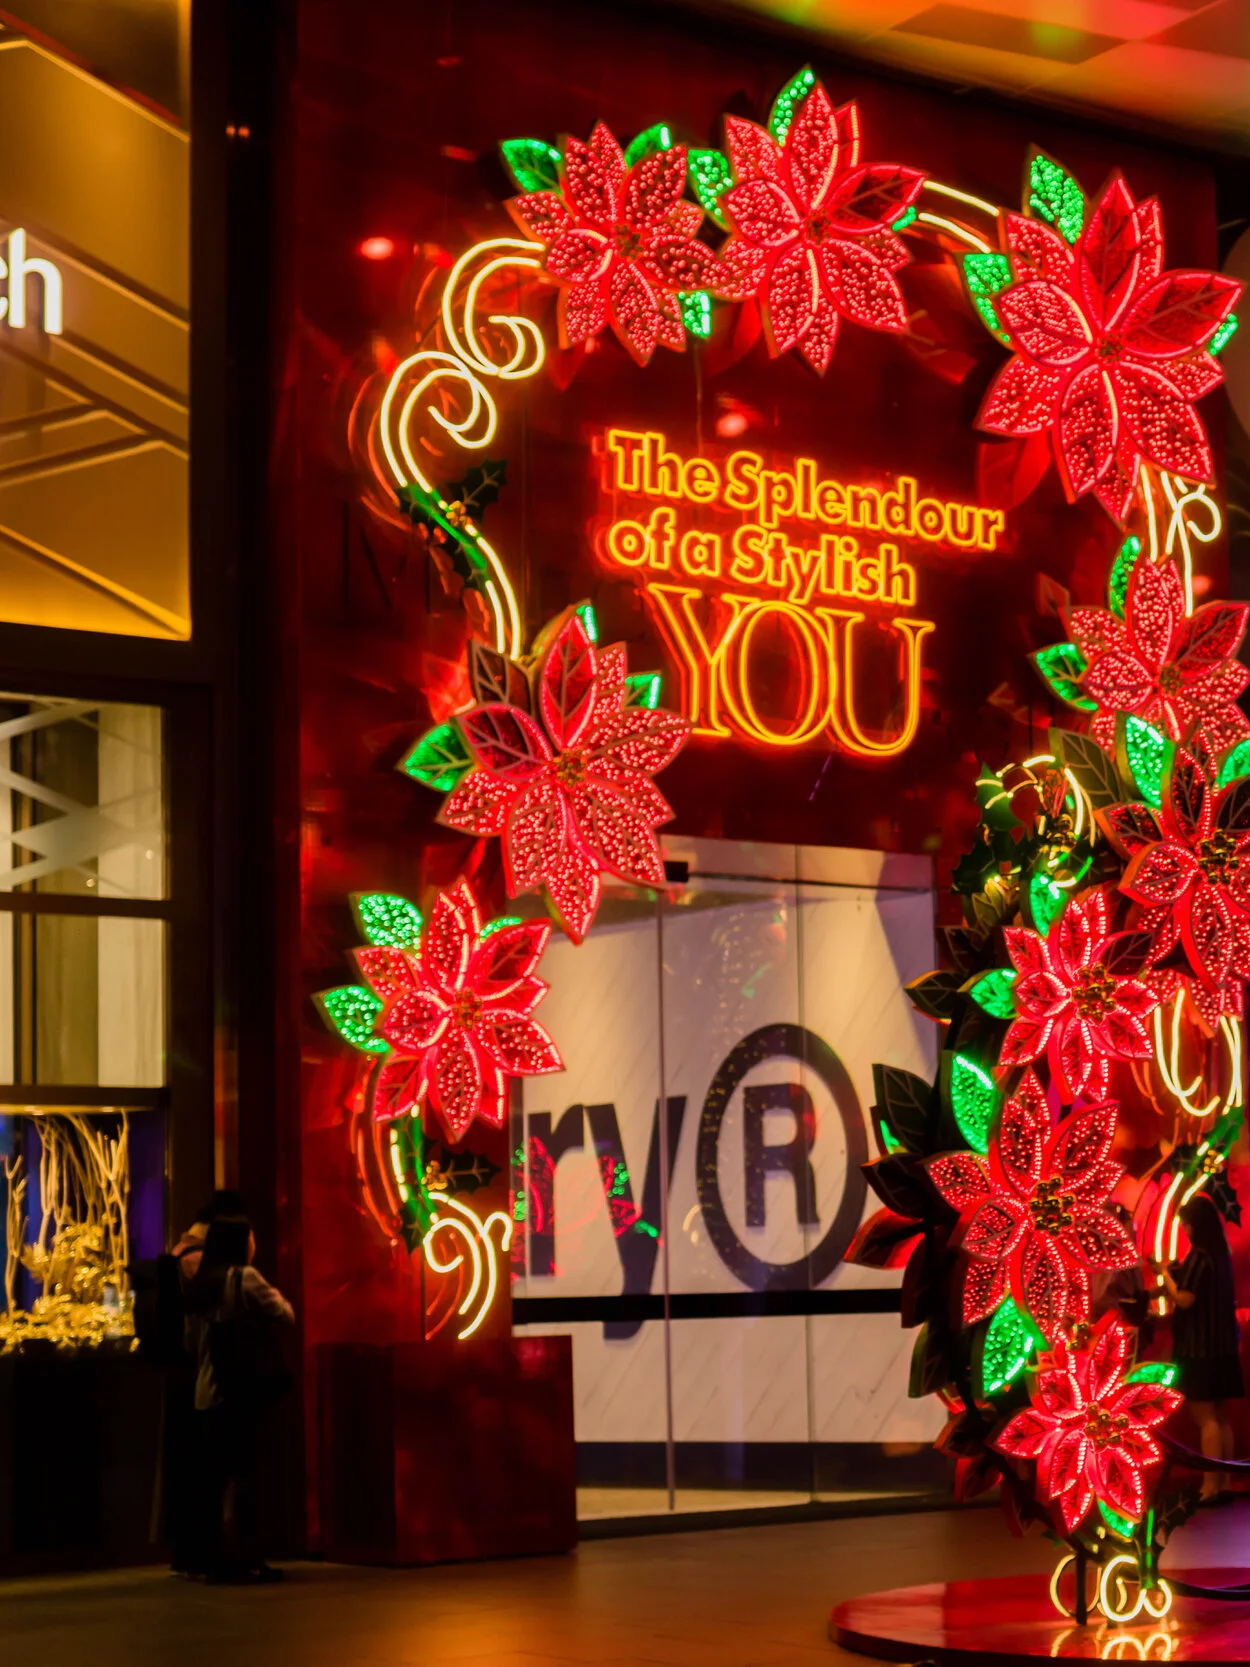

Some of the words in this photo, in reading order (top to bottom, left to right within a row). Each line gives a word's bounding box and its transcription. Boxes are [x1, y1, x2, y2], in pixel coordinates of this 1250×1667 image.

[608, 430, 720, 503] The
[724, 450, 1005, 551] Splendour
[607, 507, 676, 569] of
[681, 530, 722, 577] a
[730, 524, 917, 606] Stylish
[647, 583, 936, 756] YOU
